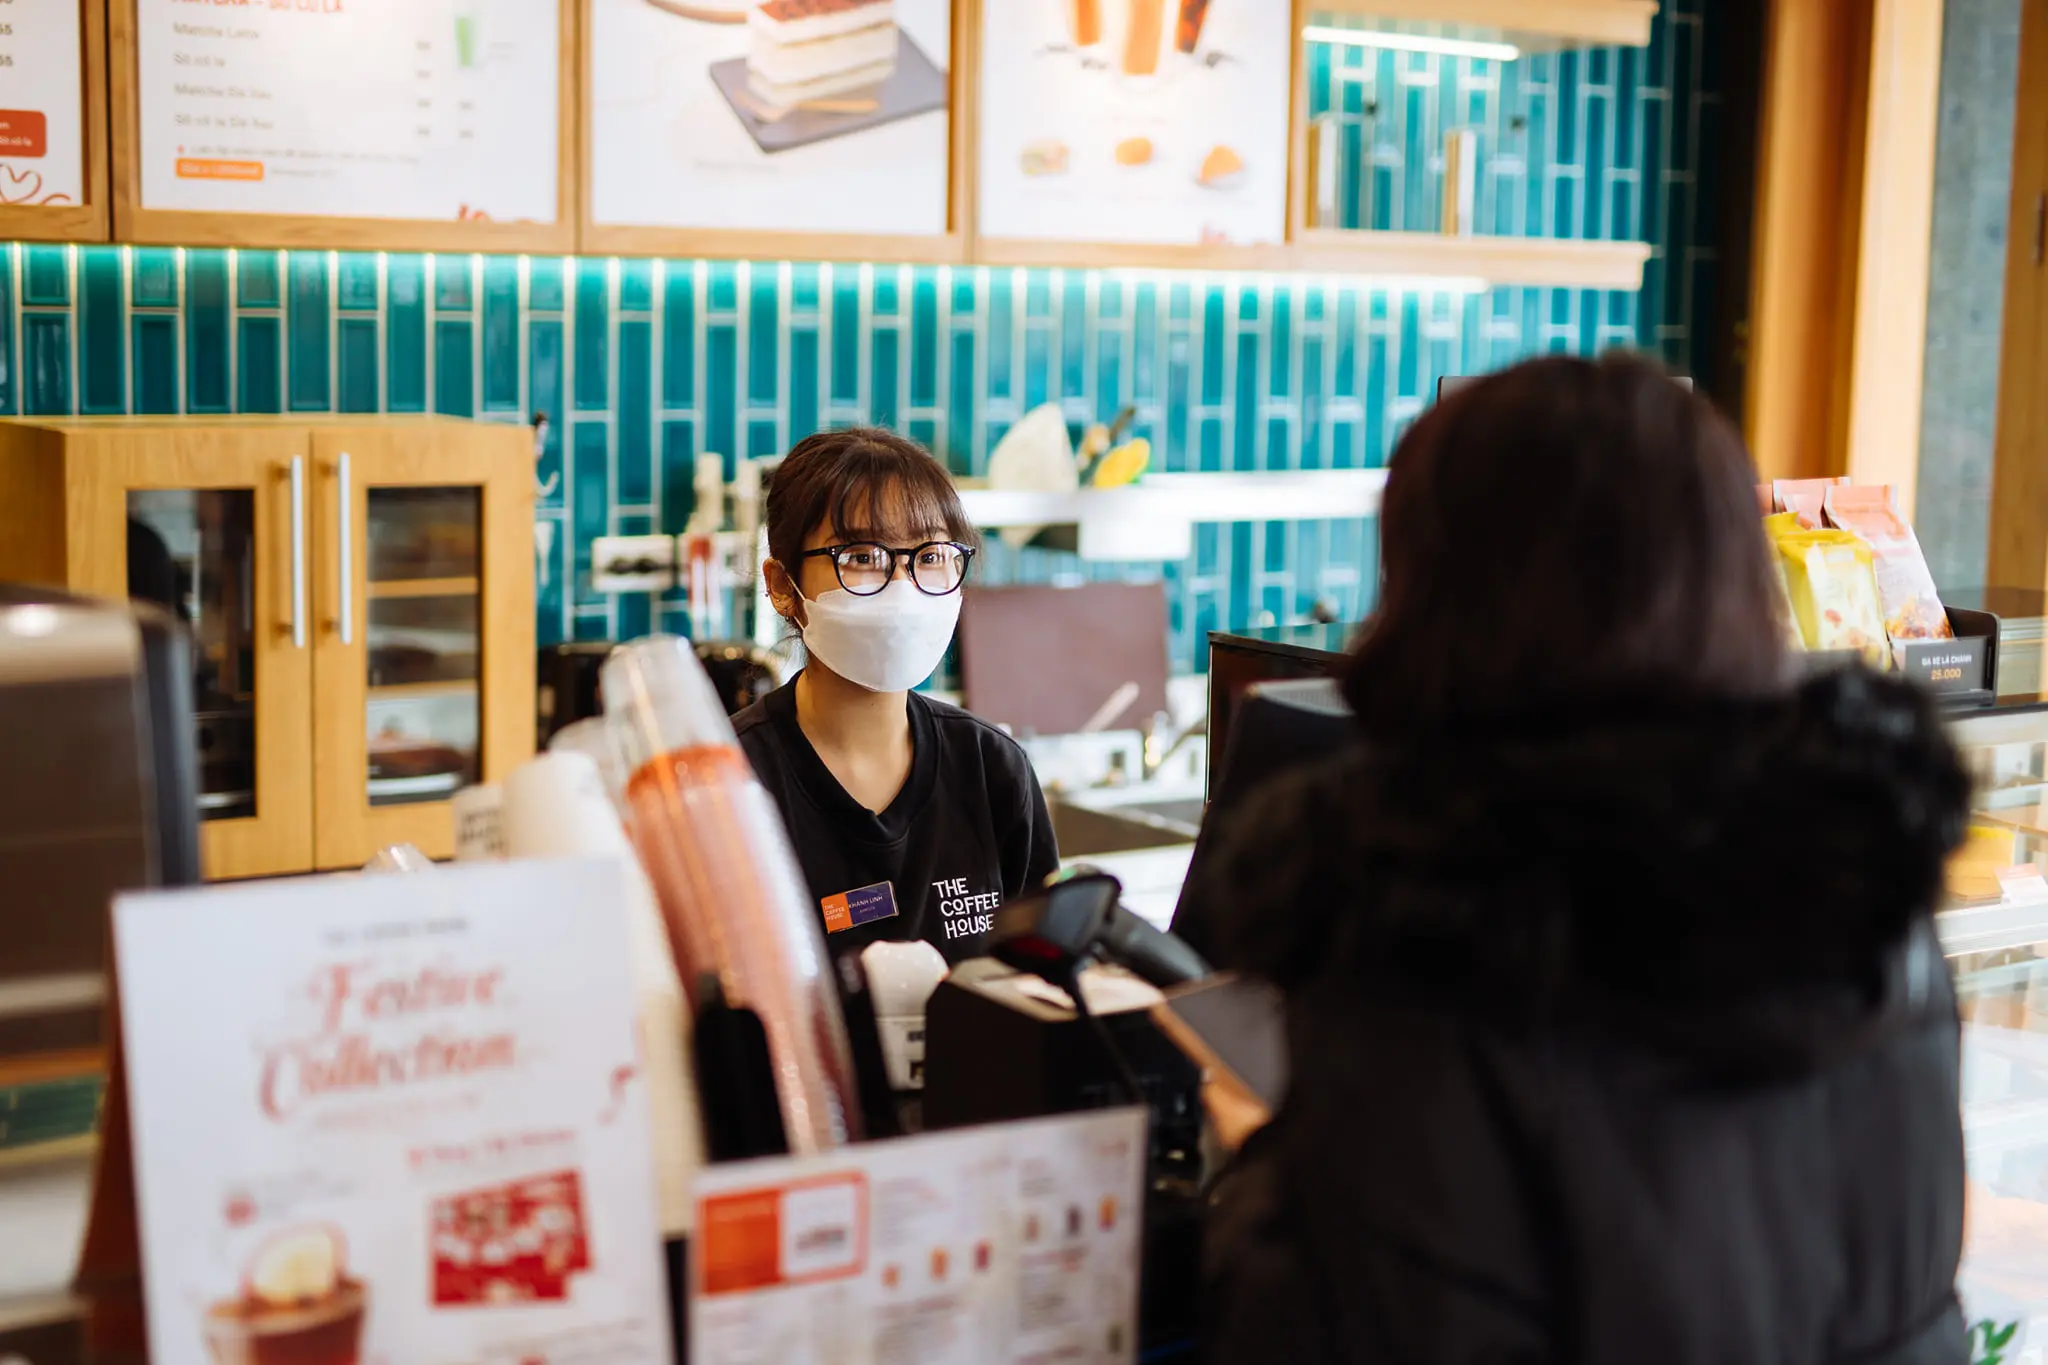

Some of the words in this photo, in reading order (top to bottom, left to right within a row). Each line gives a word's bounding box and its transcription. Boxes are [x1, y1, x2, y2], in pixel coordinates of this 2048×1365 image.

[931, 877, 969, 899] THE
[940, 891, 1000, 917] COFFEE
[944, 913, 995, 940] HOUSE
